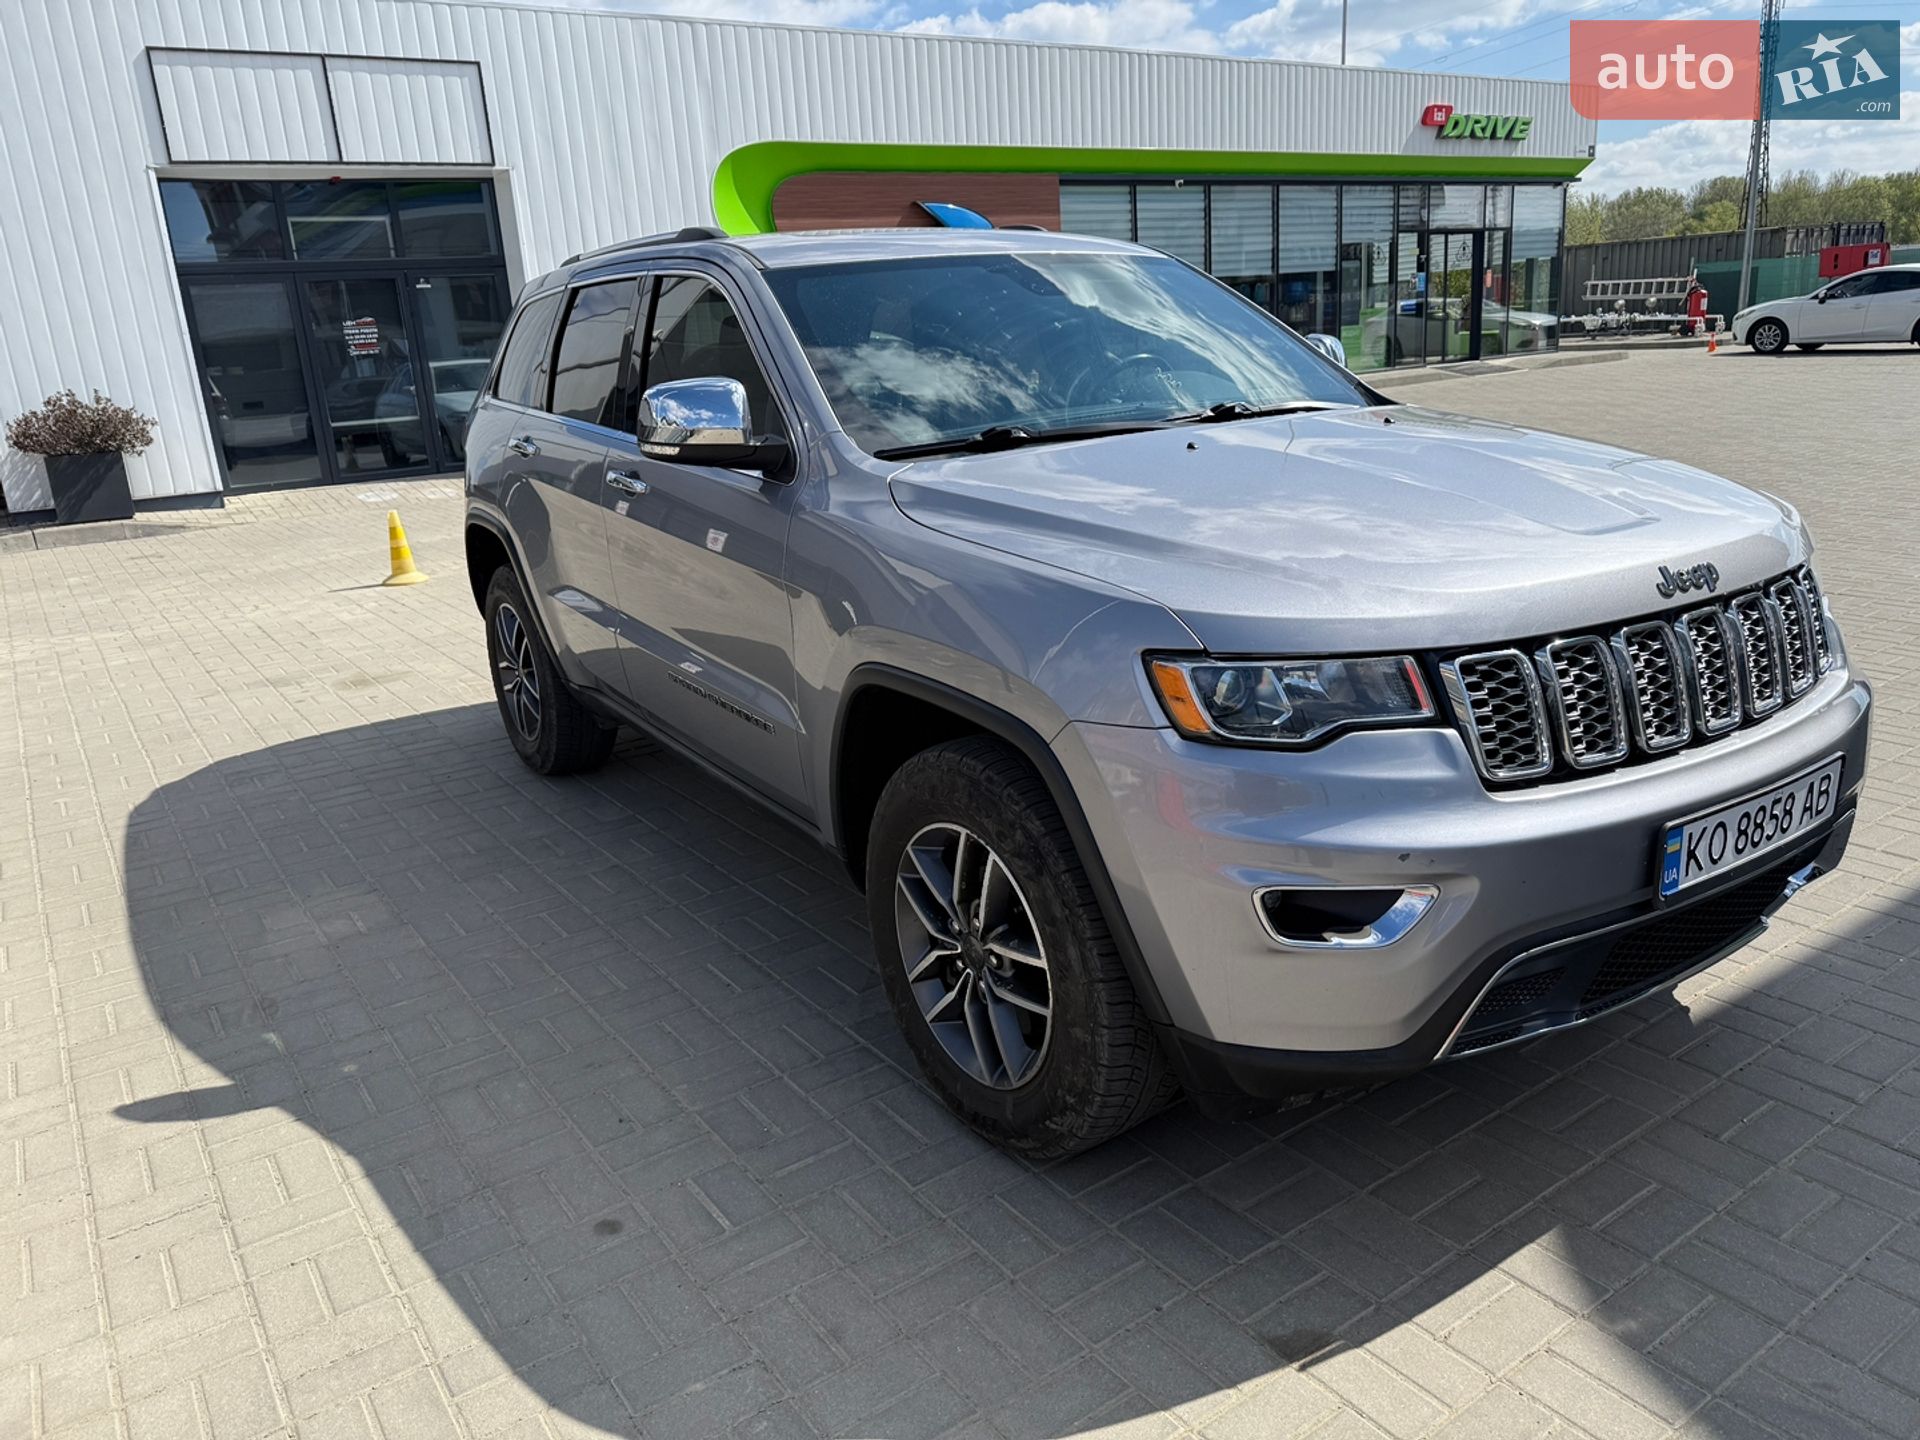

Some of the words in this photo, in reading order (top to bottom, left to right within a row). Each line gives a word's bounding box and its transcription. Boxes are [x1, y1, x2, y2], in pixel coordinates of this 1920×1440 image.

[1441, 113, 1533, 139] DRIVE
[1656, 561, 1720, 599] Jeep
[1684, 820, 1728, 877] KO
[1734, 792, 1796, 855] 8858
[1799, 773, 1832, 826] AB
[1663, 867, 1679, 883] UA
